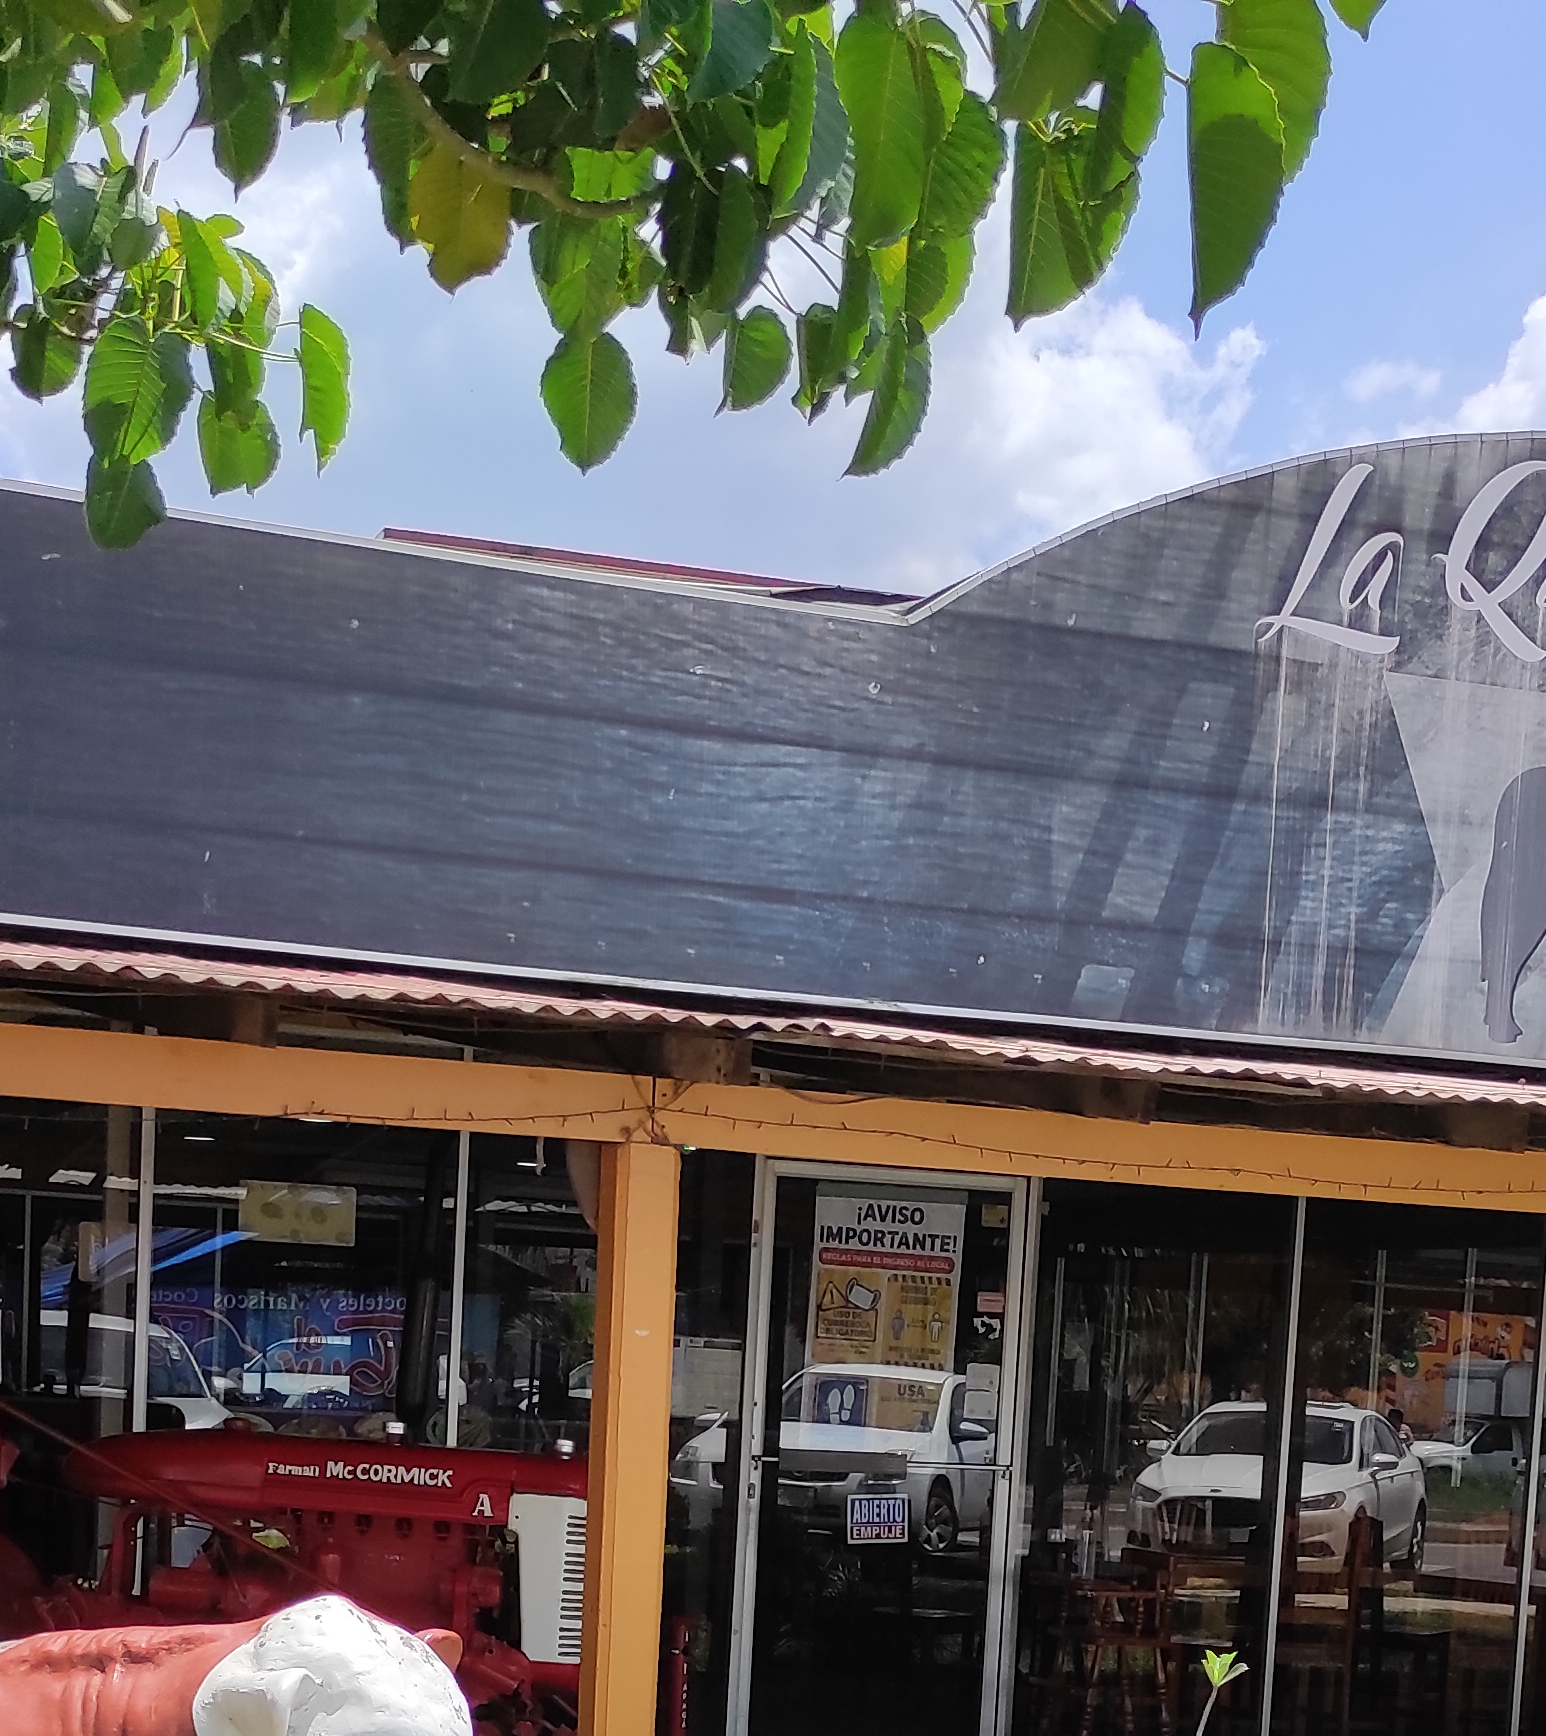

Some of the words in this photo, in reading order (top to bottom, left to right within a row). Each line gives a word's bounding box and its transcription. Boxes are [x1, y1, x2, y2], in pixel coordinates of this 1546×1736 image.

[1254, 464, 1405, 656] La
[856, 1203, 925, 1226] ¡AVISO
[819, 1225, 958, 1254] IMPORTANTE!
[822, 1252, 851, 1262] REGLAS
[853, 1254, 872, 1263] PARA
[873, 1256, 881, 1264] EL
[883, 1256, 915, 1267] INGRESO
[917, 1259, 926, 1268] AL
[927, 1260, 950, 1270] LOCAL
[897, 1383, 926, 1398] USA
[267, 1462, 320, 1477] Farmall
[472, 1493, 494, 1517] A
[852, 1498, 904, 1524] ABIERTO
[852, 1525, 904, 1539] EMPUJE
